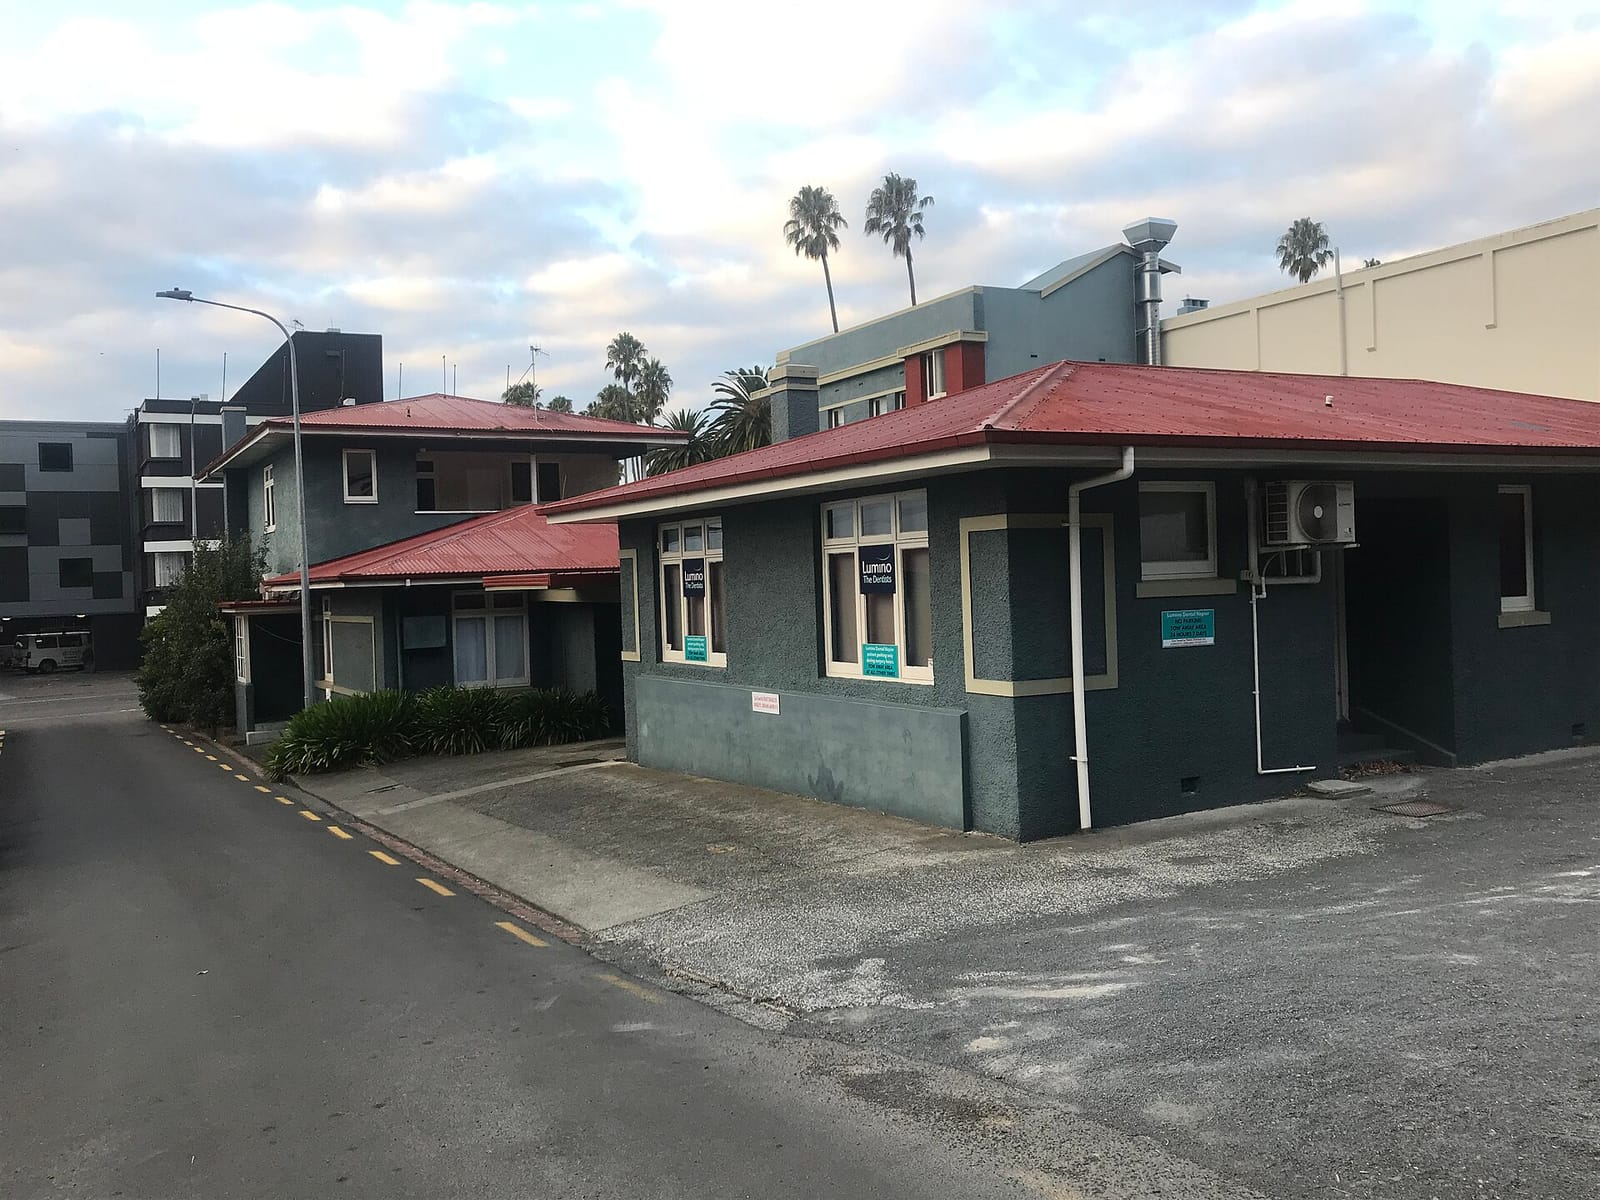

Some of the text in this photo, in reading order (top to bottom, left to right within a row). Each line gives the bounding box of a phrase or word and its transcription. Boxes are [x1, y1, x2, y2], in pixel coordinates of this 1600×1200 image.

[862, 560, 892, 574] Lumino
[684, 570, 703, 581] Lumino
[863, 575, 892, 584] The Dentists
